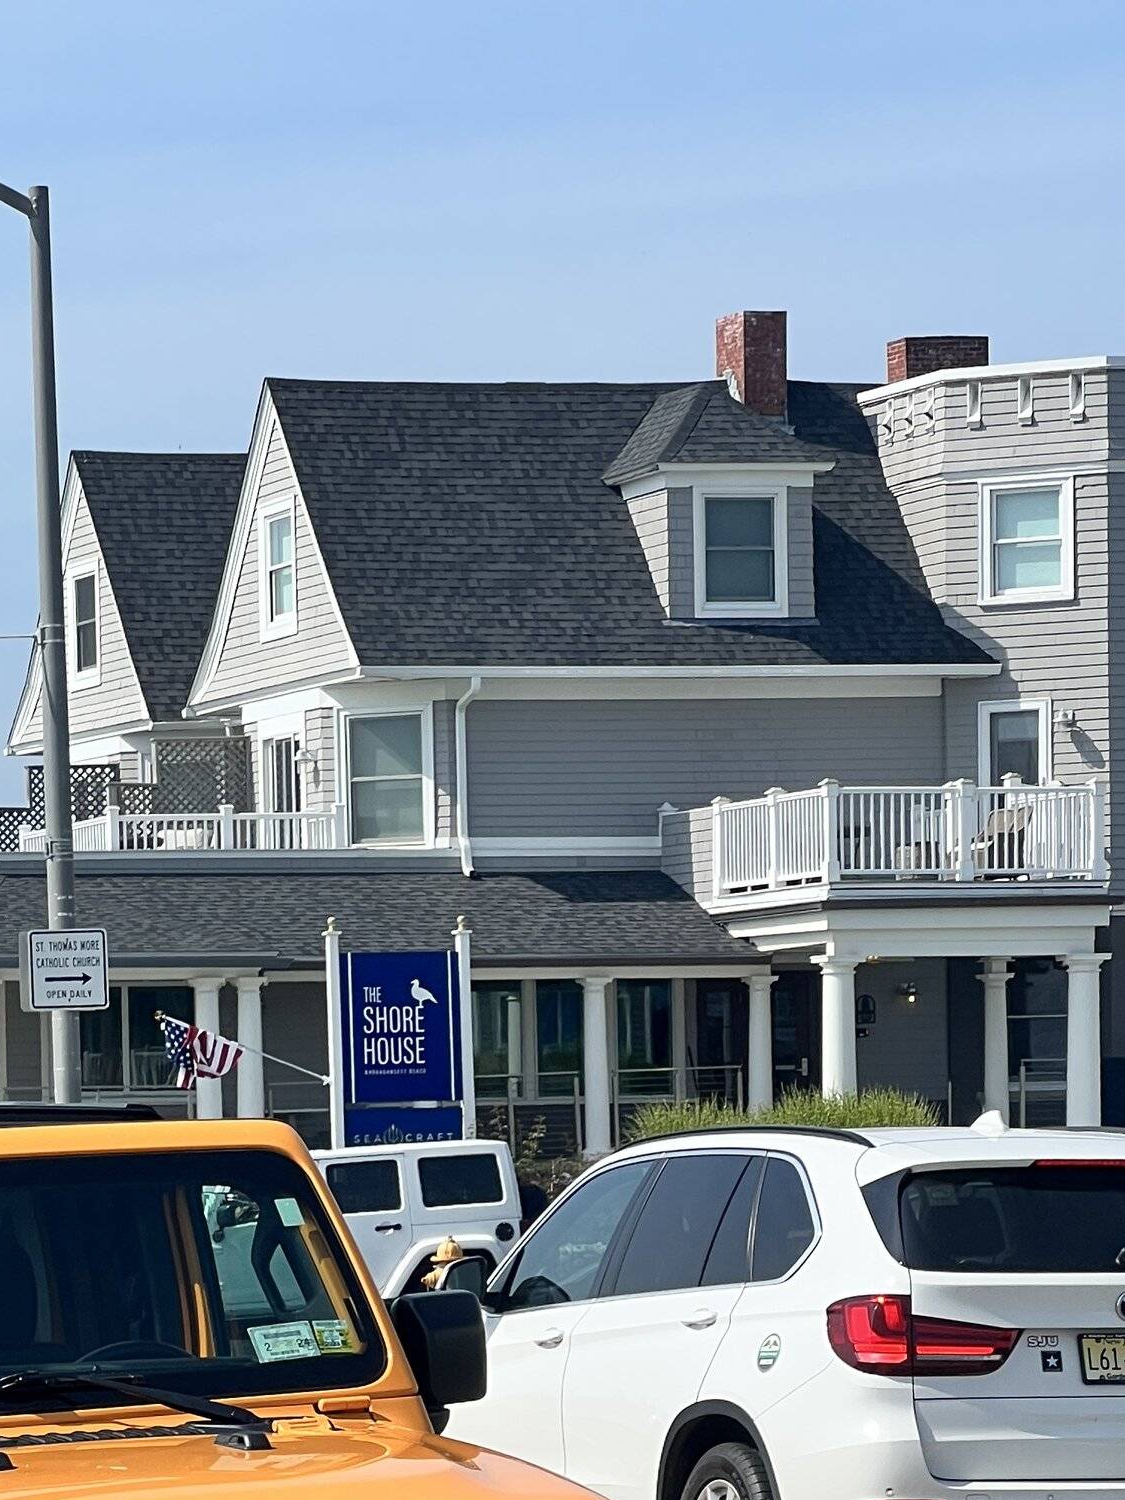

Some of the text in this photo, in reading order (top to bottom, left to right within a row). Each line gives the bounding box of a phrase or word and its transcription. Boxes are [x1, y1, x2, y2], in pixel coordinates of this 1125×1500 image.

[49, 940, 78, 952] THOMAS
[80, 940, 100, 951] MORE
[36, 956, 101, 969] CATHOLIC CHURCH
[46, 989, 92, 999] OPEN DAILY
[363, 986, 382, 1003] THE
[363, 1005, 425, 1034] SHORE
[363, 1036, 426, 1065] HOUSE
[354, 1132, 454, 1144] SEA CRAFT
[1027, 1335, 1059, 1347] SJU
